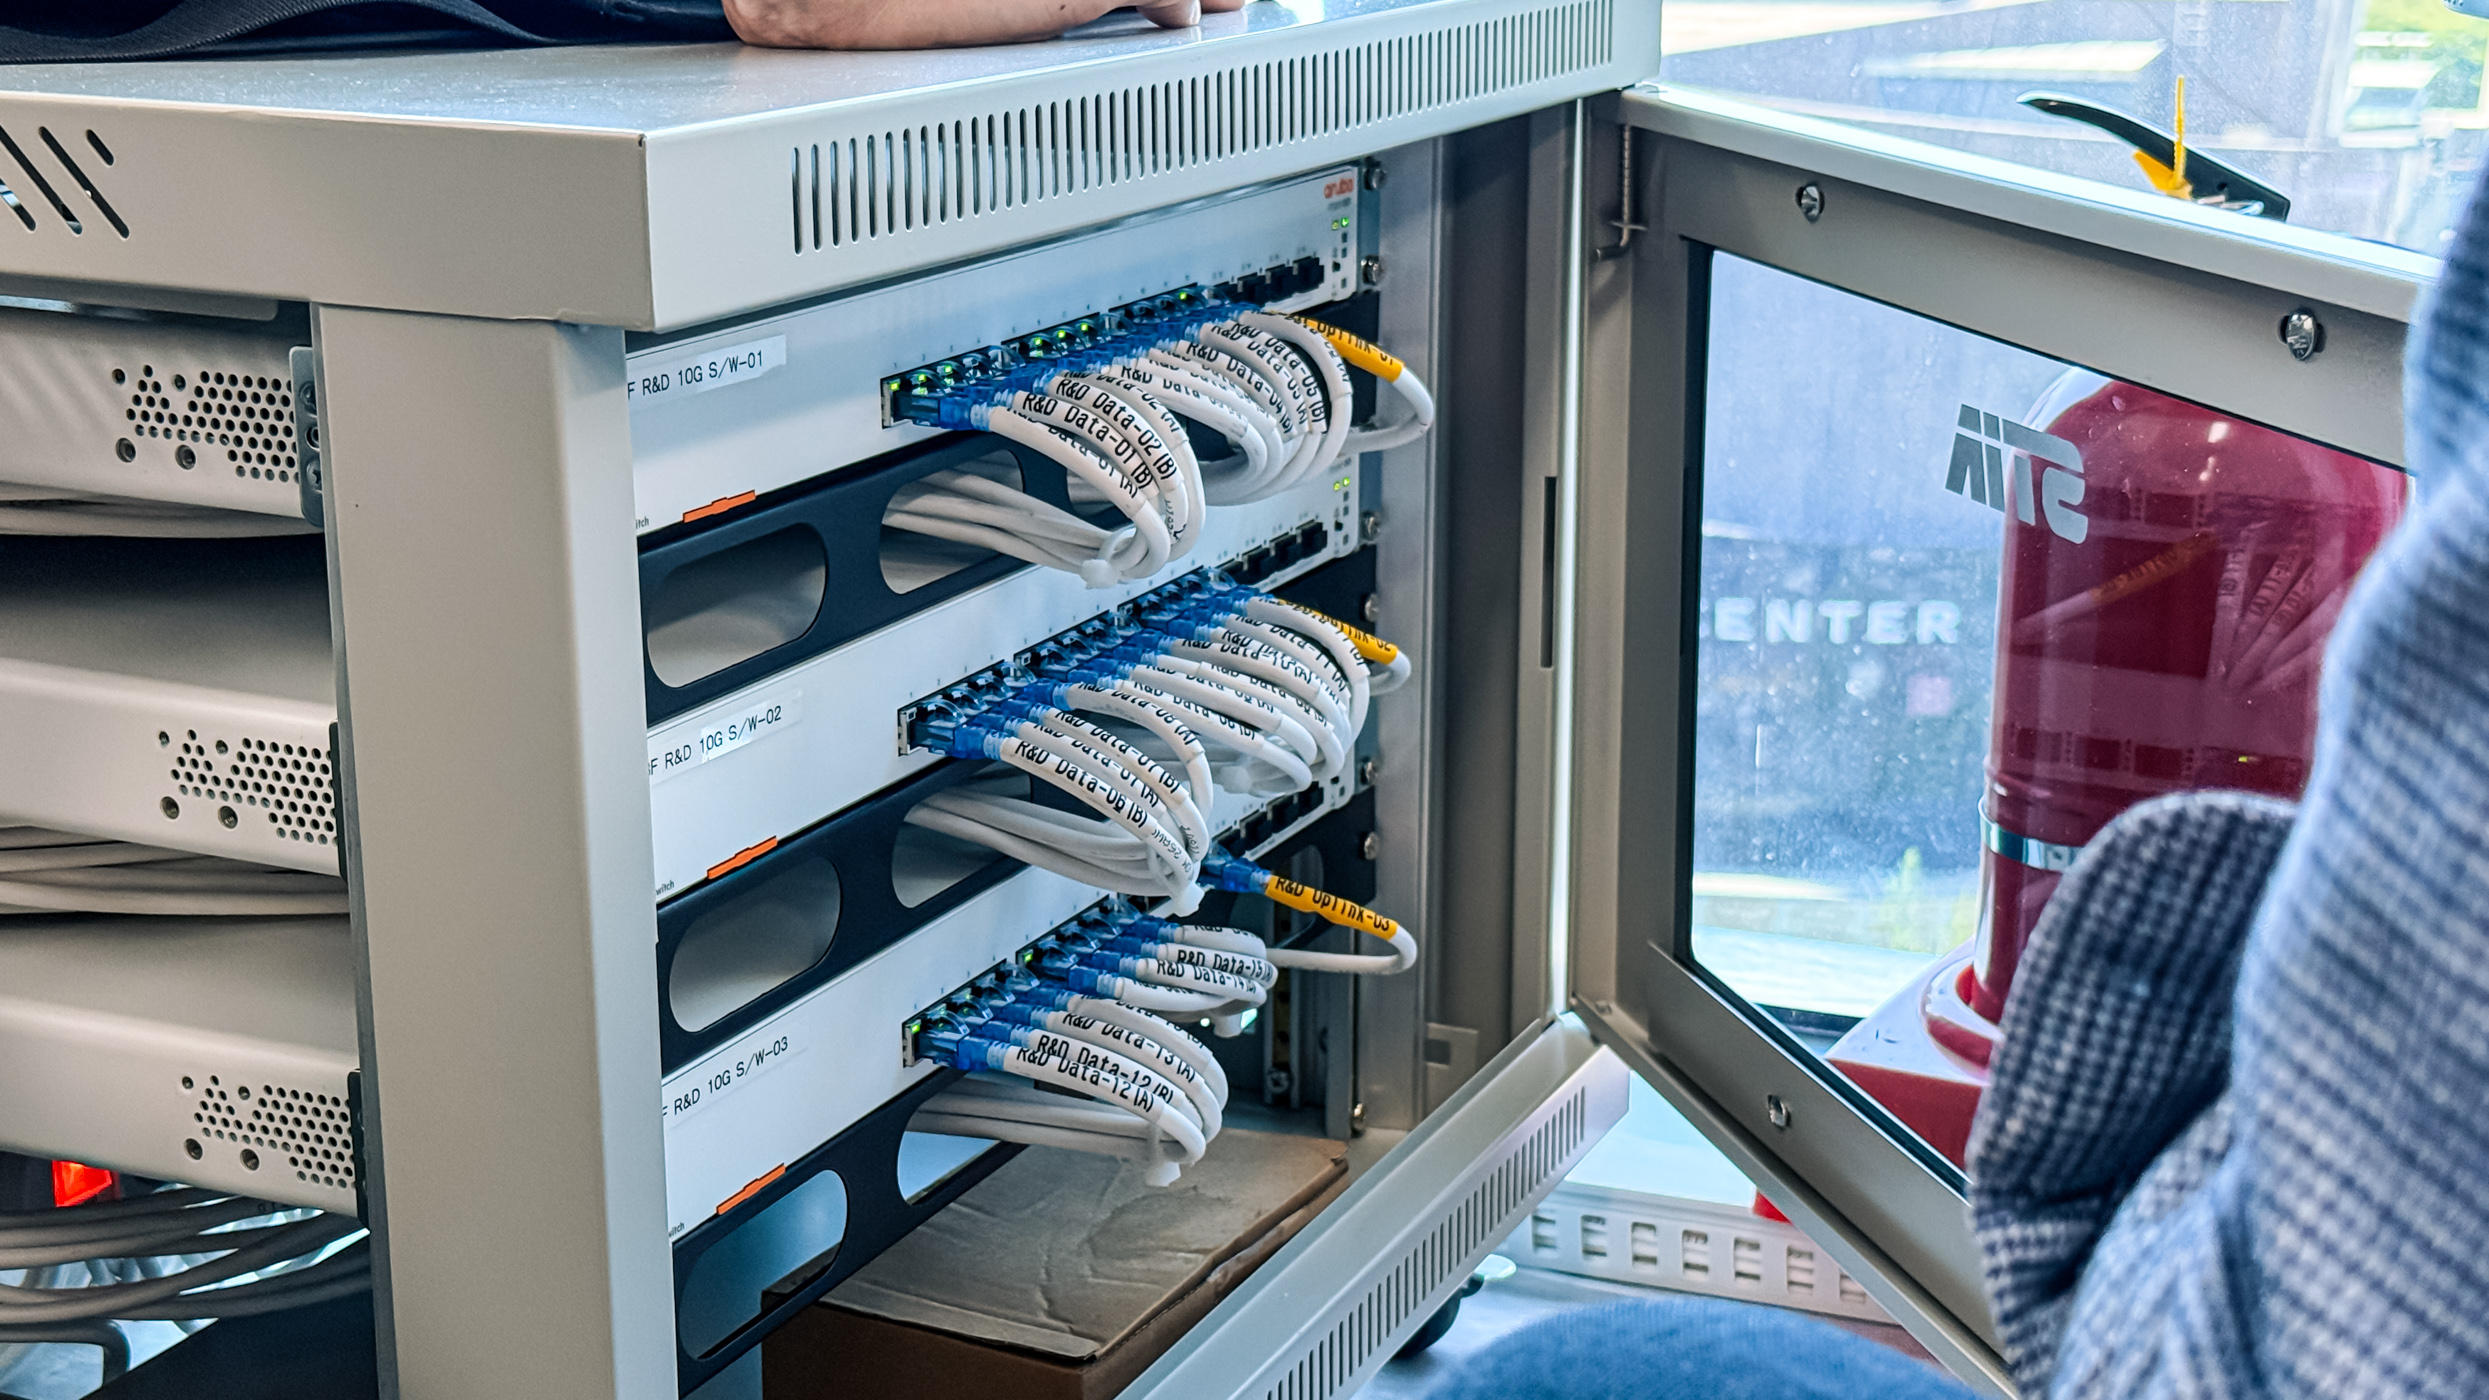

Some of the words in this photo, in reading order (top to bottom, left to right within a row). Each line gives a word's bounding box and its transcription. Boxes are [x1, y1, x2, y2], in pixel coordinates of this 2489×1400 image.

[1186, 342, 1219, 362] R&D
[642, 373, 670, 396] R&D
[678, 365, 703, 387] 10G
[709, 350, 764, 379] S/W-01
[1056, 379, 1091, 401] R&D
[1022, 393, 1058, 417] R&D
[1701, 597, 1961, 645] ENTER
[665, 744, 692, 769] R&D
[699, 731, 723, 754] 10G
[728, 705, 782, 741] S/W-02
[1015, 740, 1050, 765] R&D
[1275, 877, 1305, 897] R&D
[1157, 960, 1185, 978] R&D
[1017, 1047, 1049, 1066] R&D
[1037, 1034, 1070, 1057] R&D
[674, 1088, 701, 1115] R&D
[708, 1070, 731, 1094] 10G
[736, 1036, 788, 1076] S/W-03
